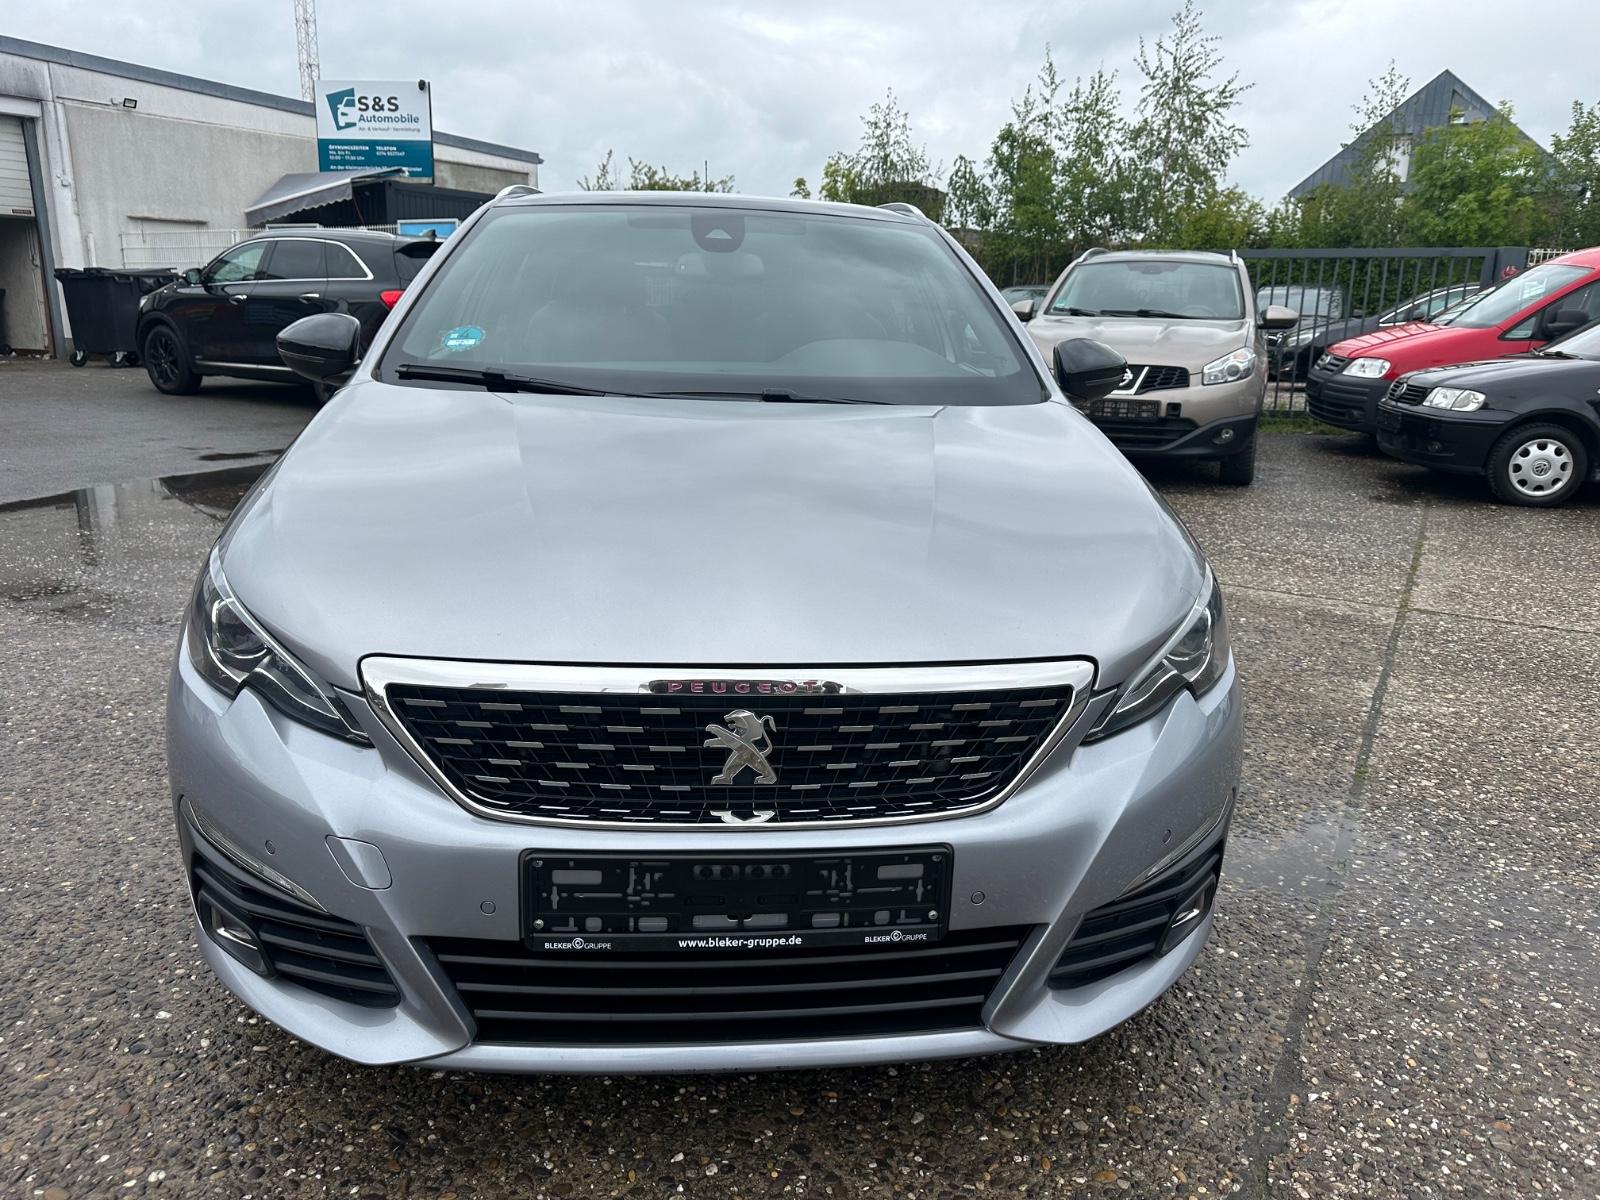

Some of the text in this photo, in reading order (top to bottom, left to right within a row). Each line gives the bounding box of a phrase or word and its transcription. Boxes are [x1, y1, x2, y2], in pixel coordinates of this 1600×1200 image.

[357, 96, 399, 112] S&S
[358, 113, 420, 123] Automobile
[667, 680, 819, 694] PEUGEOT
[678, 935, 802, 948] www.bleker-gruppe.de
[864, 933, 928, 943] BLEKER GRUPPE
